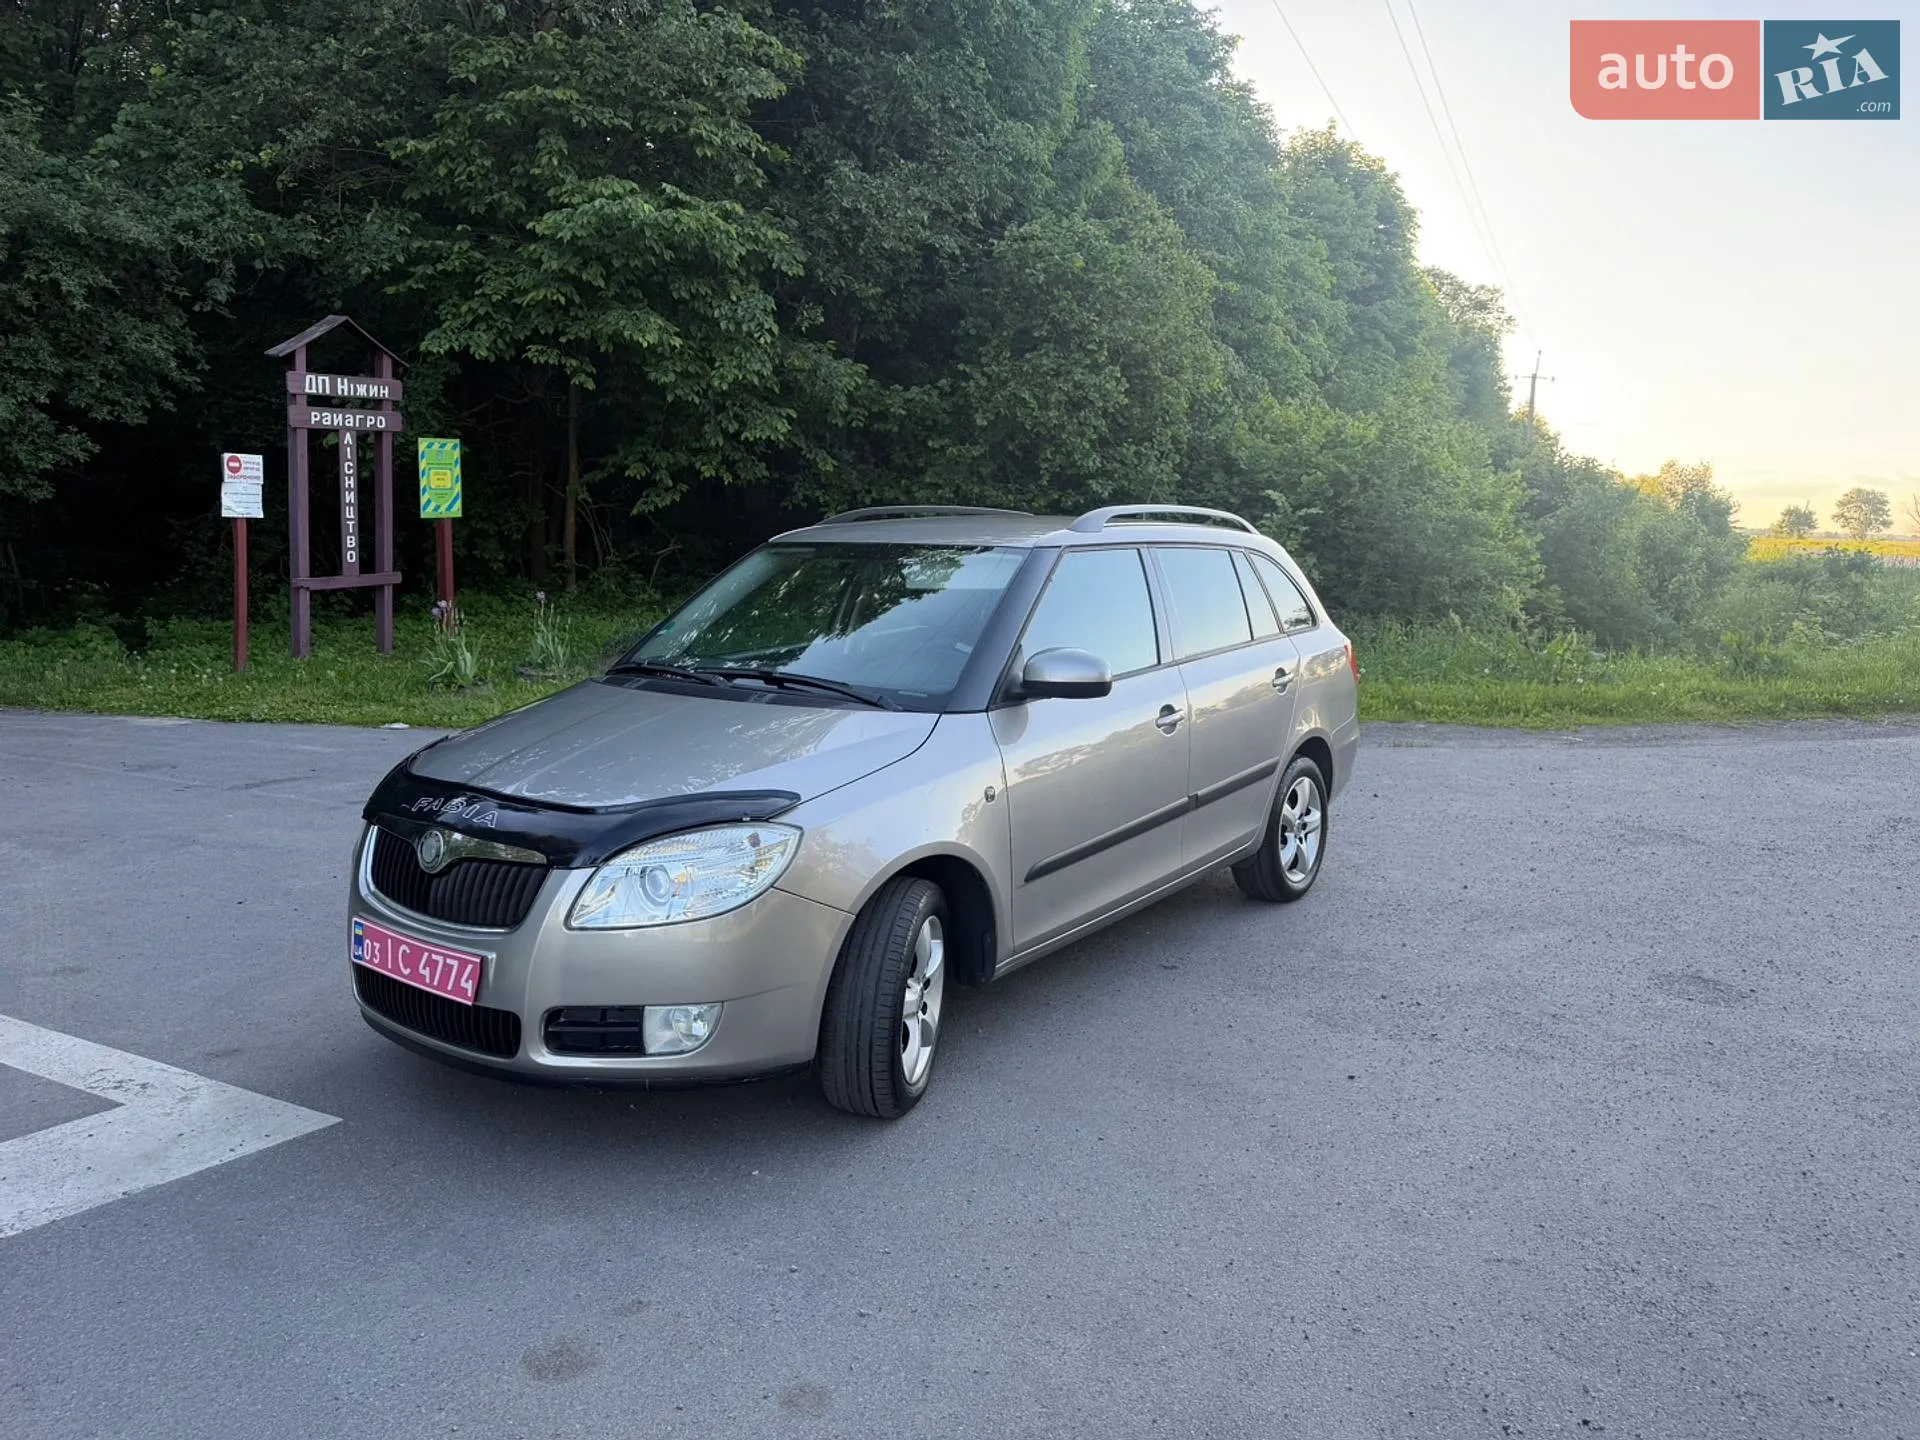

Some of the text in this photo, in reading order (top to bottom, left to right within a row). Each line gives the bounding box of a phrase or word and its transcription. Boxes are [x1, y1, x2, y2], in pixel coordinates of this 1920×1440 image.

[304, 374, 390, 398] ДП Ніжин
[343, 432, 357, 563] ЛІСНИЦТВО
[411, 797, 498, 828] FABIA
[363, 939, 381, 964] 03
[419, 951, 474, 998] 4774
